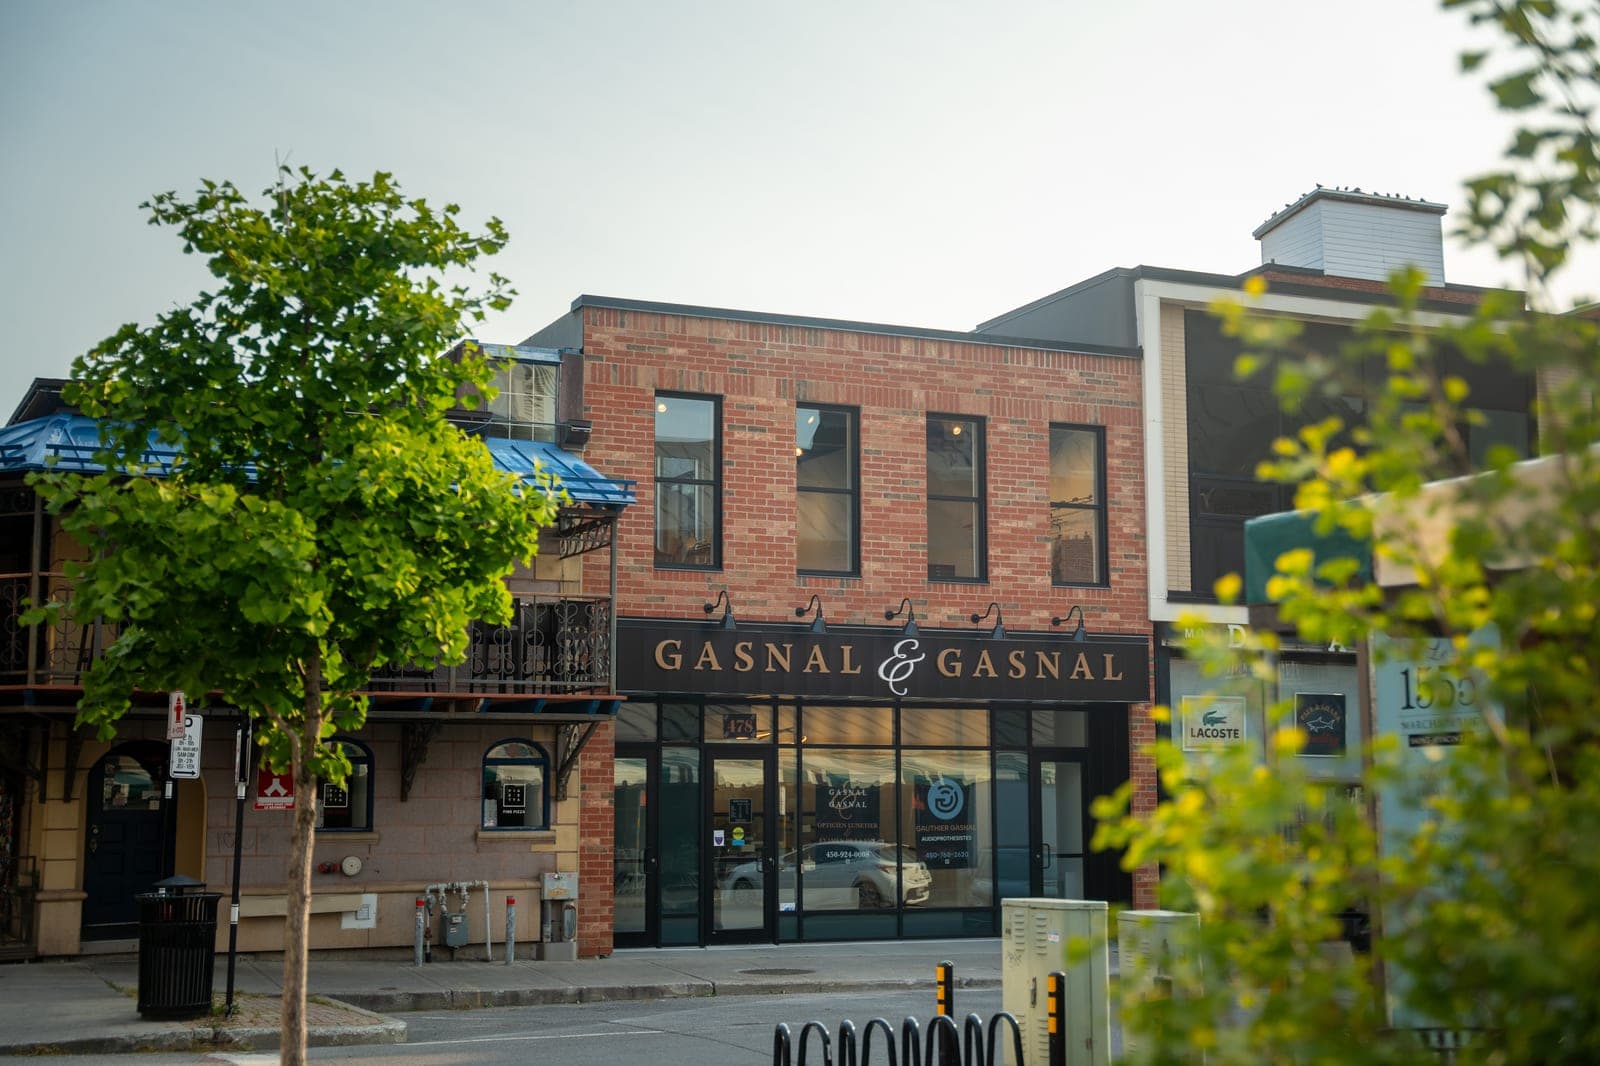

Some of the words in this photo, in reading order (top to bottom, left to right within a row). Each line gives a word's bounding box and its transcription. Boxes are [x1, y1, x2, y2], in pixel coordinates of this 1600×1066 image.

[655, 639, 862, 674] GASNAL
[878, 638, 926, 696] &
[936, 648, 1123, 681] GASNAL
[727, 719, 753, 733] 478
[1190, 727, 1240, 740] LACOSTE
[828, 788, 868, 796] GASNAL
[915, 824, 949, 832] GAUTHIER
